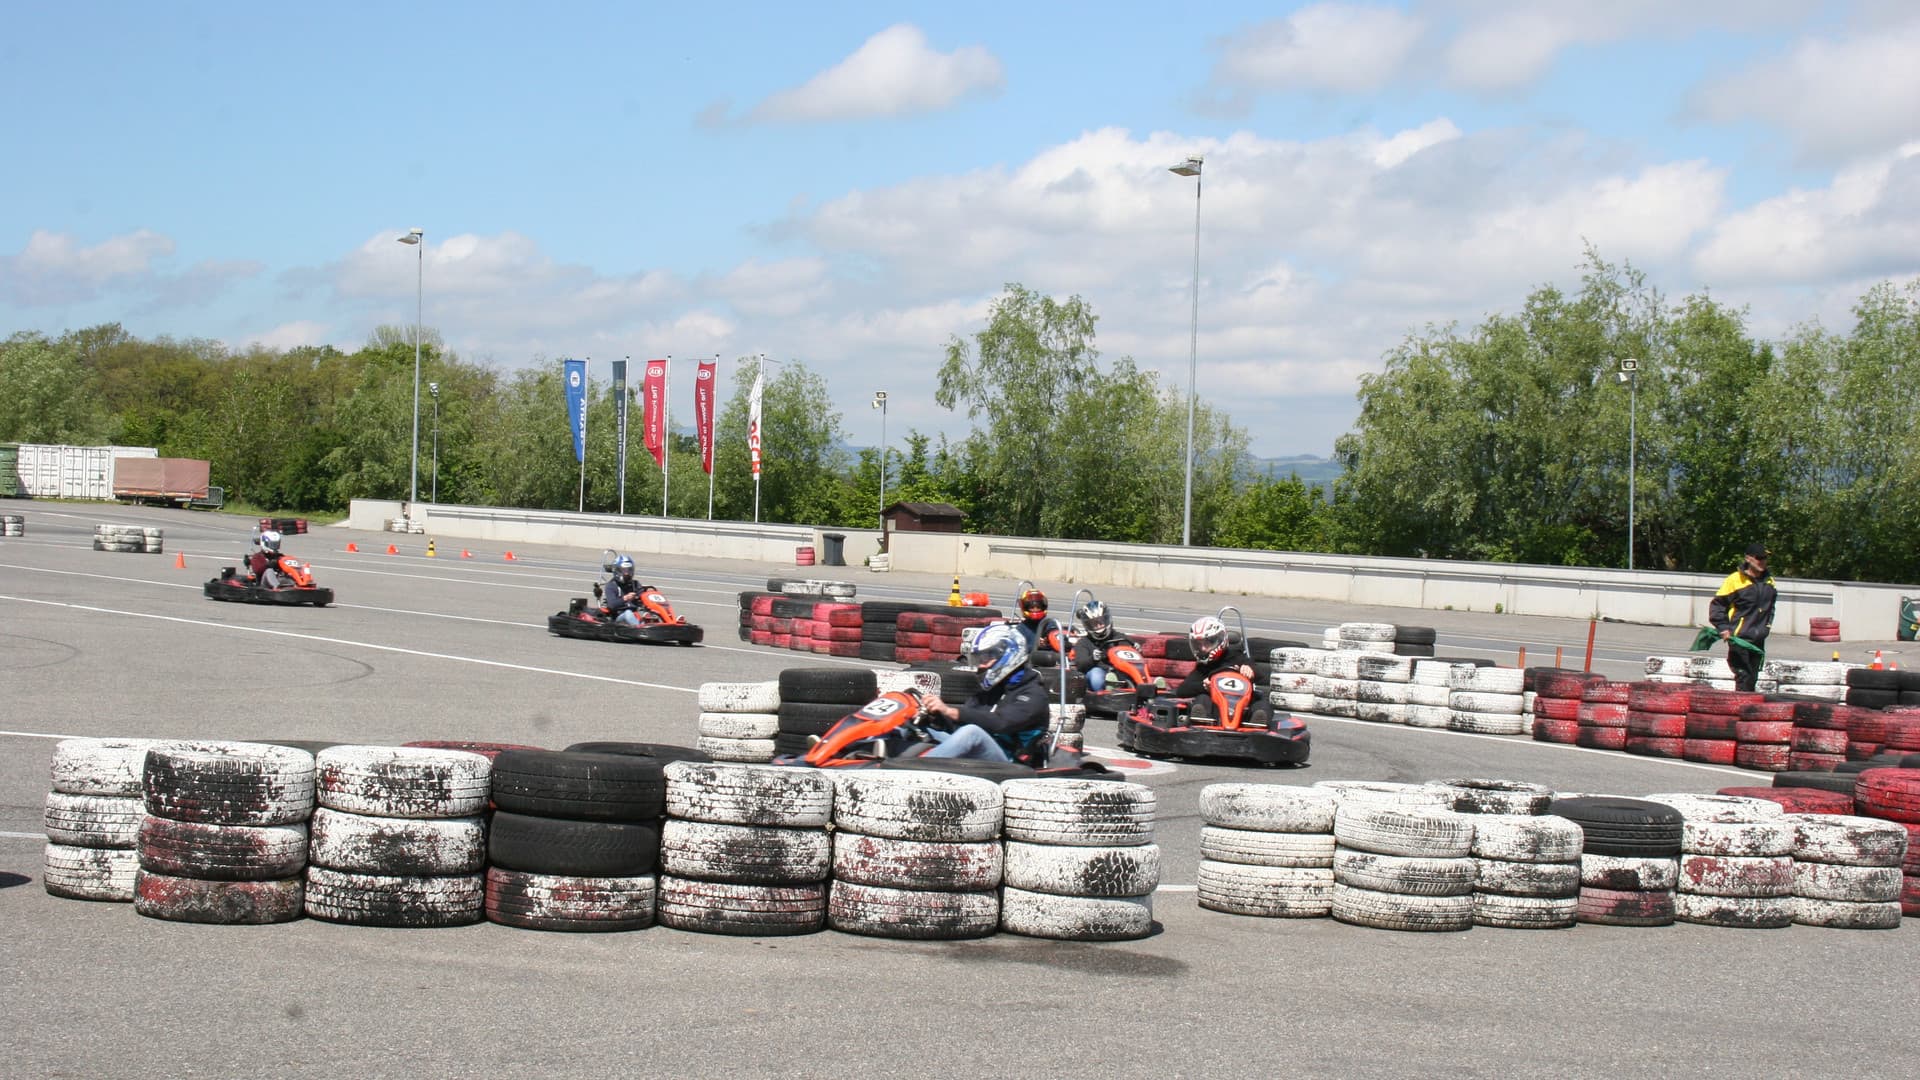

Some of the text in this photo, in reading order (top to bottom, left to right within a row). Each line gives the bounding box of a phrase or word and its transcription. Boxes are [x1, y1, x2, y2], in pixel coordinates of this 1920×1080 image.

[1123, 651, 1134, 659] 9
[1224, 679, 1236, 689] 4
[866, 699, 896, 714] 24
